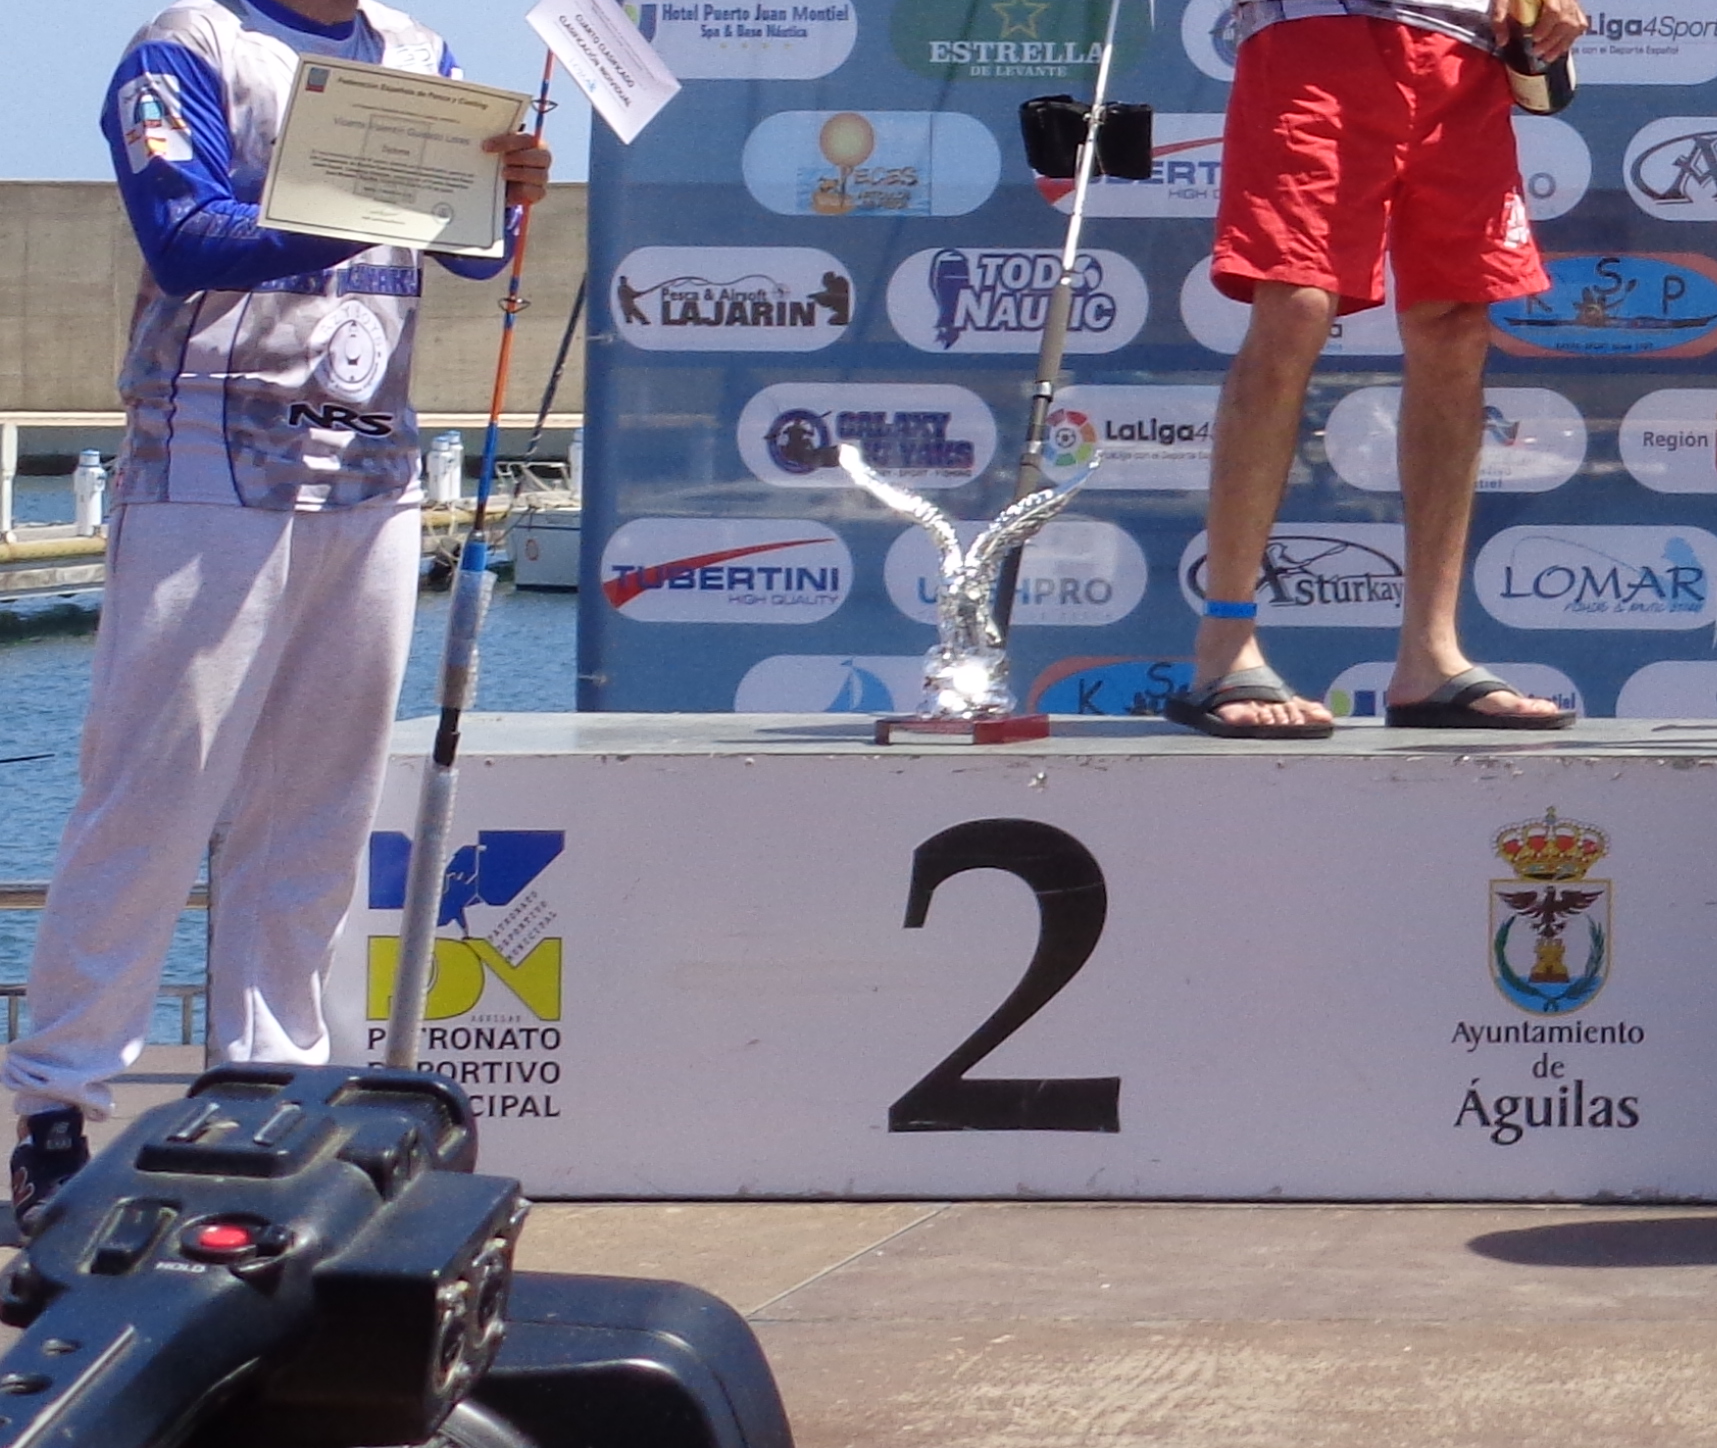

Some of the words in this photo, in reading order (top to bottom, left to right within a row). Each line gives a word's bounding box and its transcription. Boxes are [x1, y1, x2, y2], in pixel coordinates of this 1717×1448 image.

[662, 3, 699, 22] Hotel
[703, 4, 751, 22] Puerto
[755, 4, 789, 22] Juan
[793, 4, 849, 22] Montiel
[929, 40, 1105, 64] ESTRELLA
[970, 65, 985, 77] DE
[990, 65, 1067, 78] LEVANTE
[663, 287, 697, 301] Pesca
[719, 287, 767, 301] Airsoft
[660, 301, 816, 327] LAJARIN
[288, 402, 394, 437] NRS
[1643, 430, 1709, 451] Región
[612, 565, 839, 591] TUBERTINI
[1500, 563, 1705, 603] LOMAR
[729, 594, 767, 605] HIGH
[771, 594, 839, 605] QUALITY
[888, 817, 1122, 1134] 2
[1451, 1020, 1645, 1049] Ayuntamiento
[1531, 1052, 1566, 1080] de
[1454, 1078, 1641, 1145] Águilas
[156, 1260, 207, 1274] HOLD
